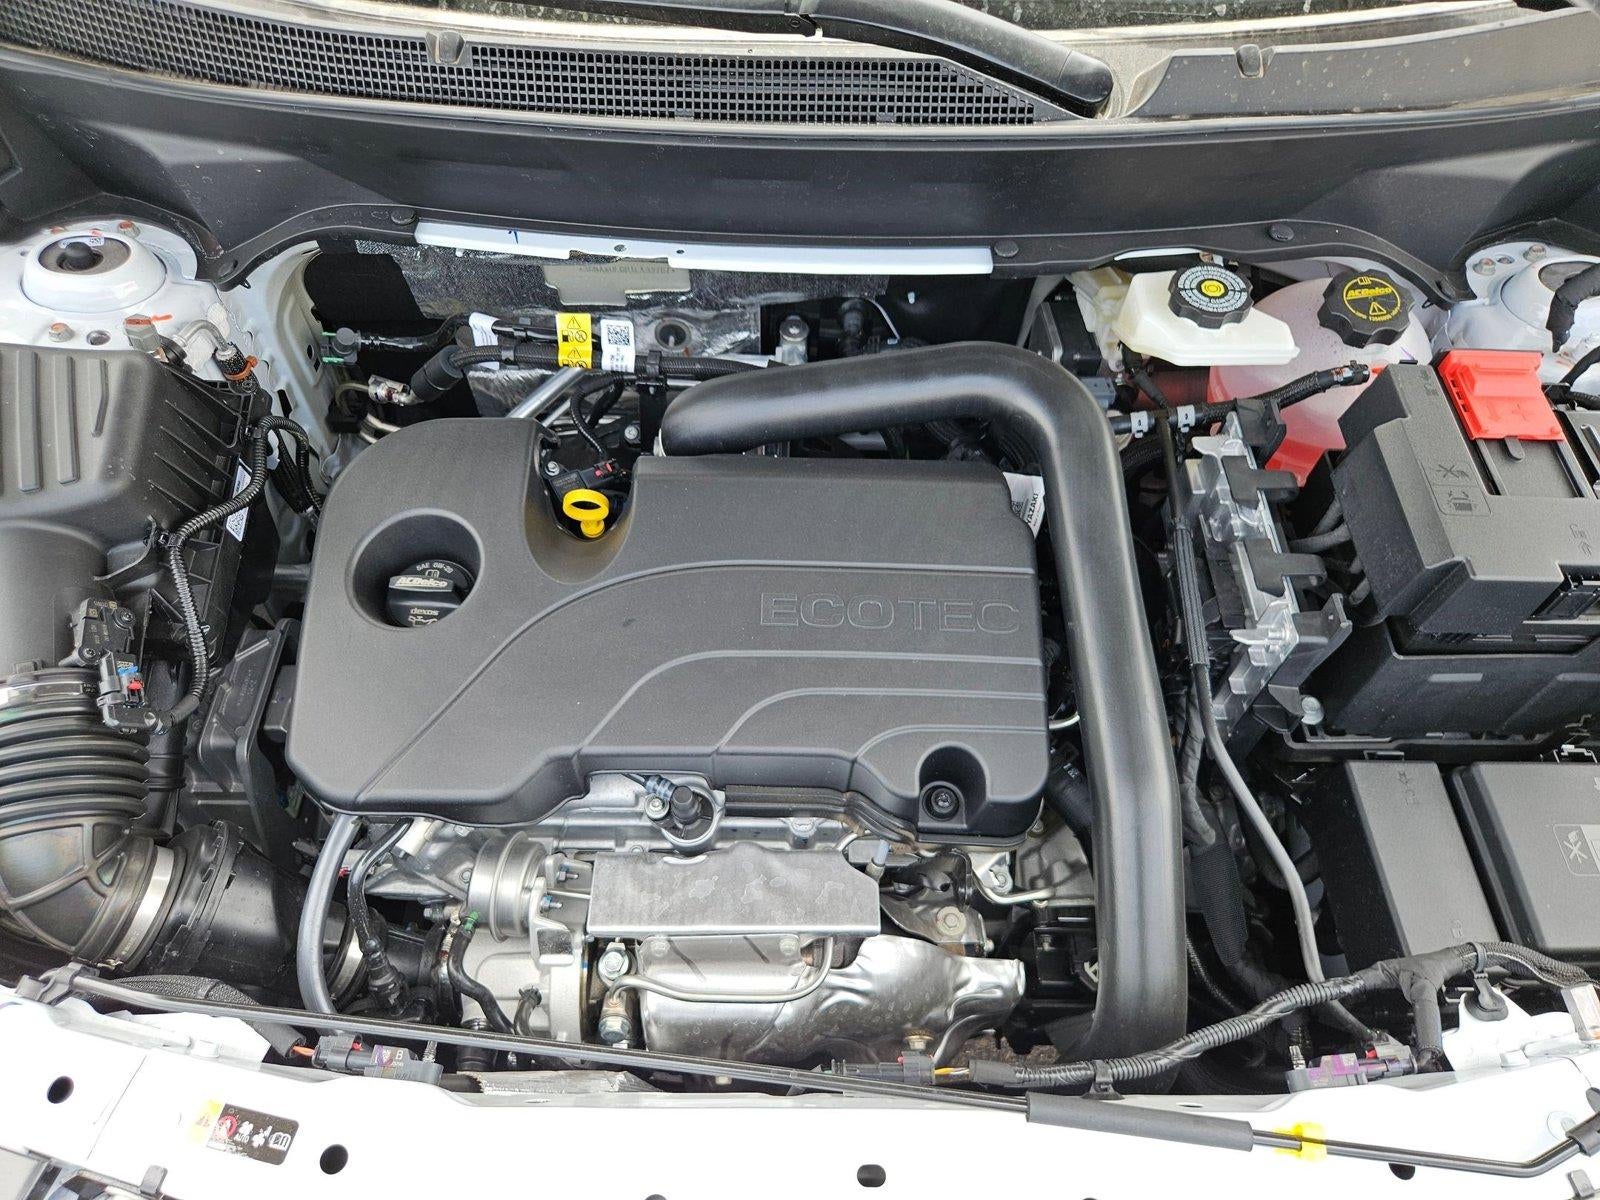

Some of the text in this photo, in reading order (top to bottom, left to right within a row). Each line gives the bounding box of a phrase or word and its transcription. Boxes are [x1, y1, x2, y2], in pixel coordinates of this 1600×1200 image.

[1347, 287, 1392, 300] ACDelco
[416, 562, 430, 571] SAE
[395, 577, 448, 587] ACDelco
[410, 608, 439, 616] dexos
[761, 592, 1019, 634] ECOTEC
